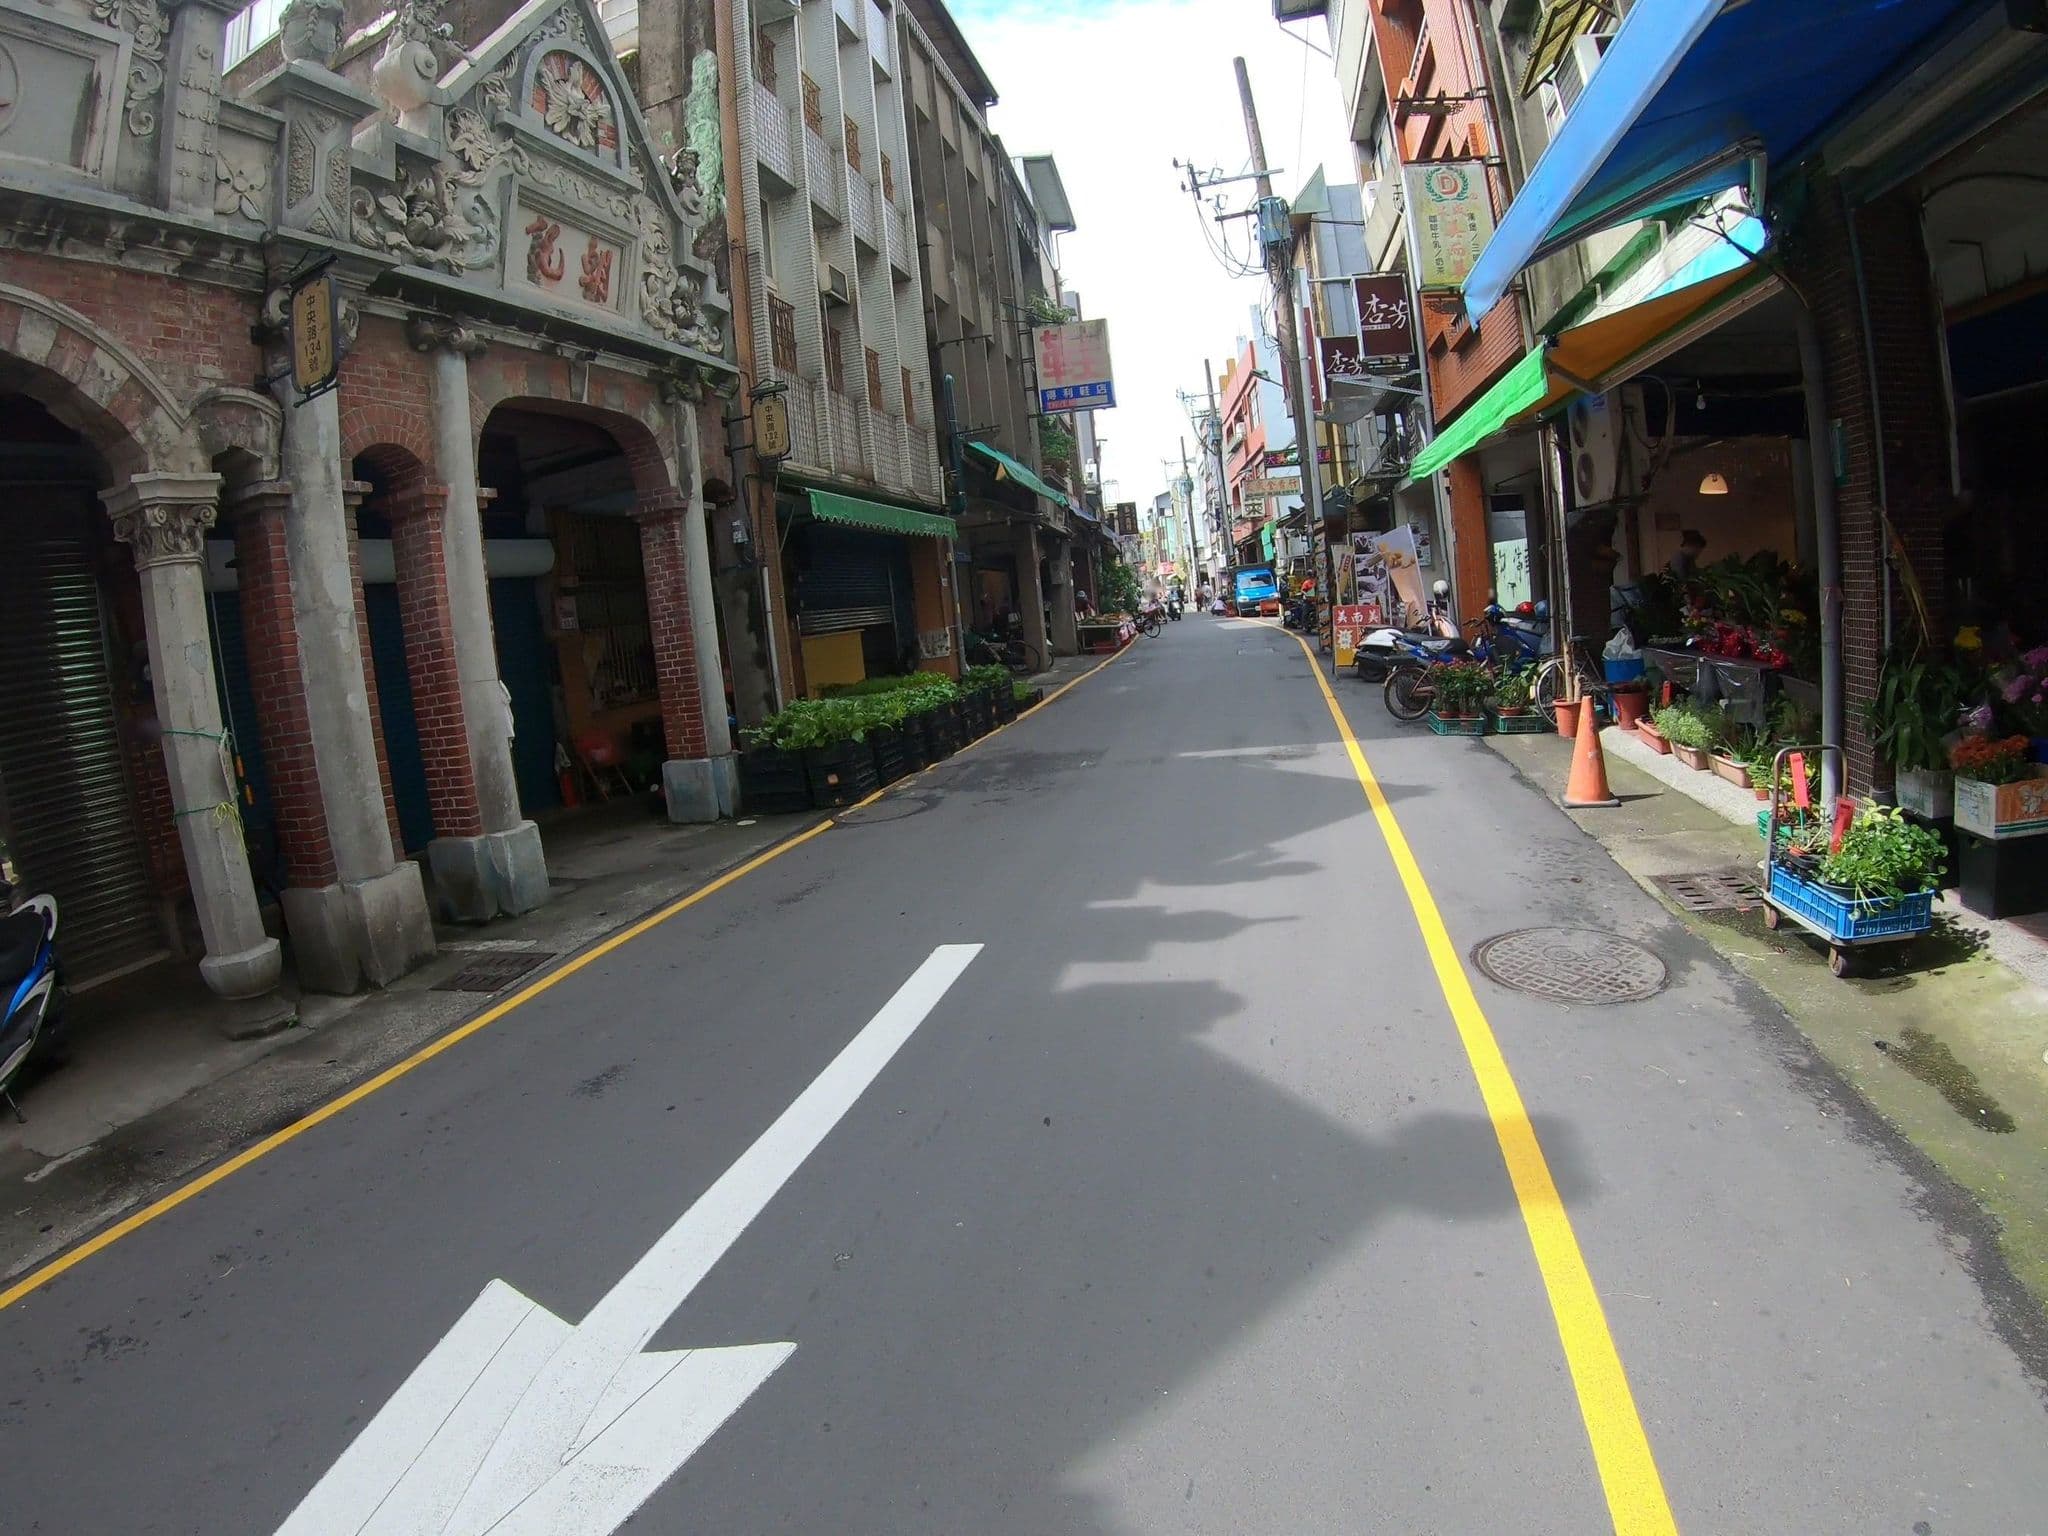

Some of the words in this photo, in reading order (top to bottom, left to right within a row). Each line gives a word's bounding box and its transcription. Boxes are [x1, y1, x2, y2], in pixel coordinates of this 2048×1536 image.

[1360, 293, 1409, 330] 杏芳
[305, 294, 322, 374] 中央路134號
[1326, 349, 1363, 376] 杏芳
[1337, 609, 1379, 624] 美而美
